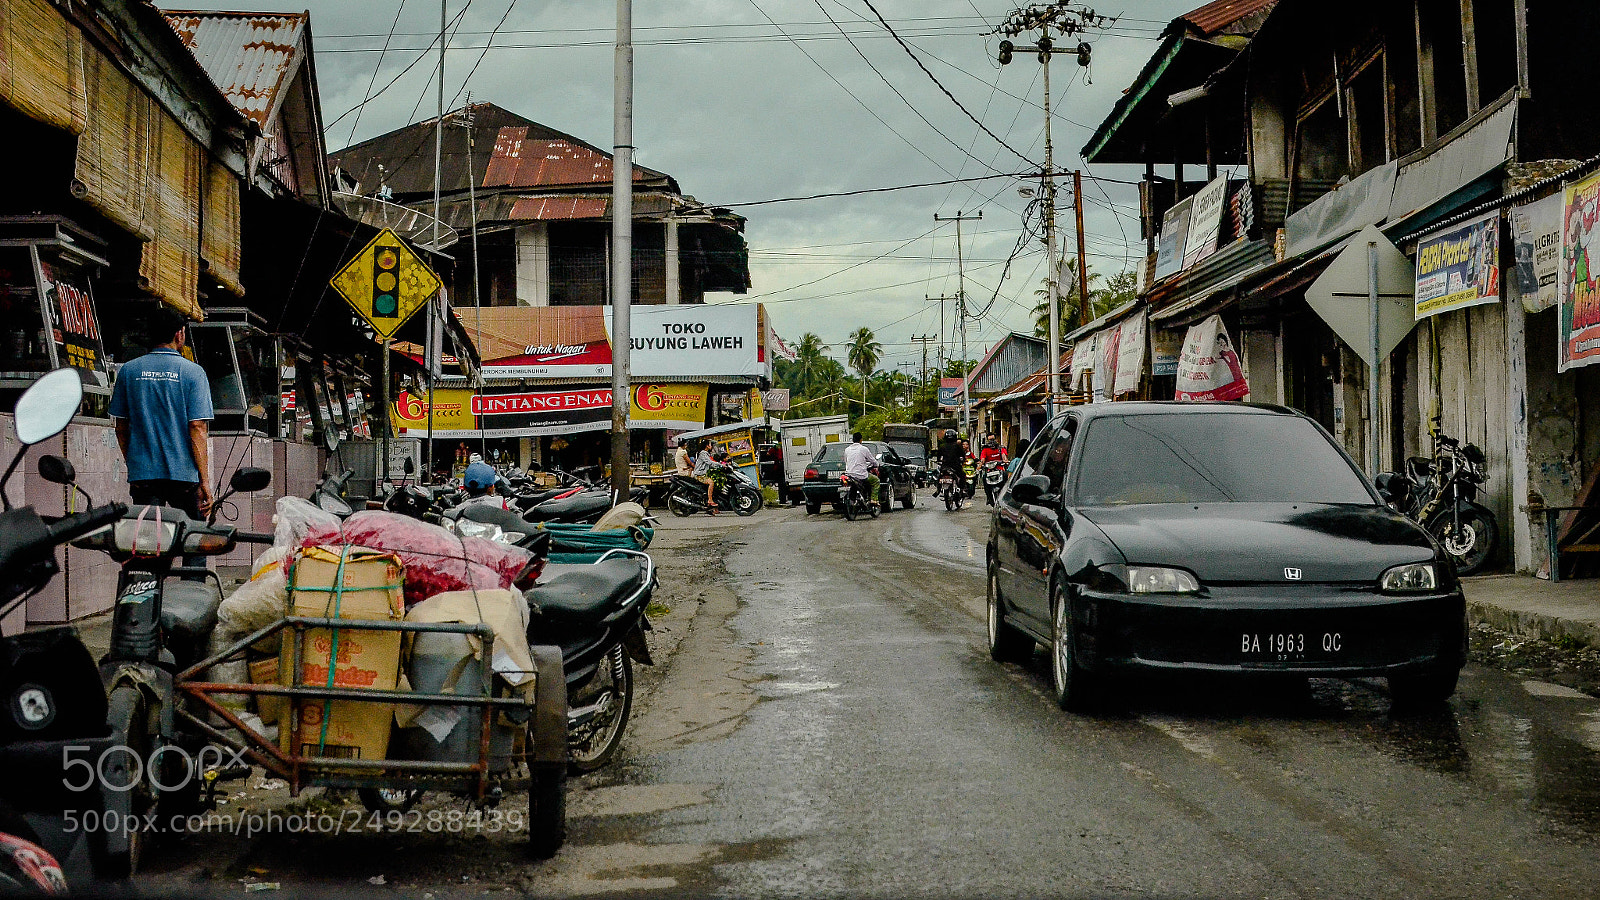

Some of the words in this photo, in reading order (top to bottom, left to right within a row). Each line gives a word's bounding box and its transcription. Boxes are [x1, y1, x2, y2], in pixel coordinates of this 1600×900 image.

[662, 323, 706, 334] TOKO
[524, 344, 552, 355] Untuk
[554, 343, 587, 355] Nagari
[629, 337, 687, 350] BUYUNG
[692, 336, 743, 350] LAWEH
[141, 370, 179, 379] INSTRUKTUR
[476, 397, 561, 411] LINTANG
[1241, 633, 1261, 653] BA
[1268, 633, 1304, 653] 1963
[1322, 632, 1342, 652] QC
